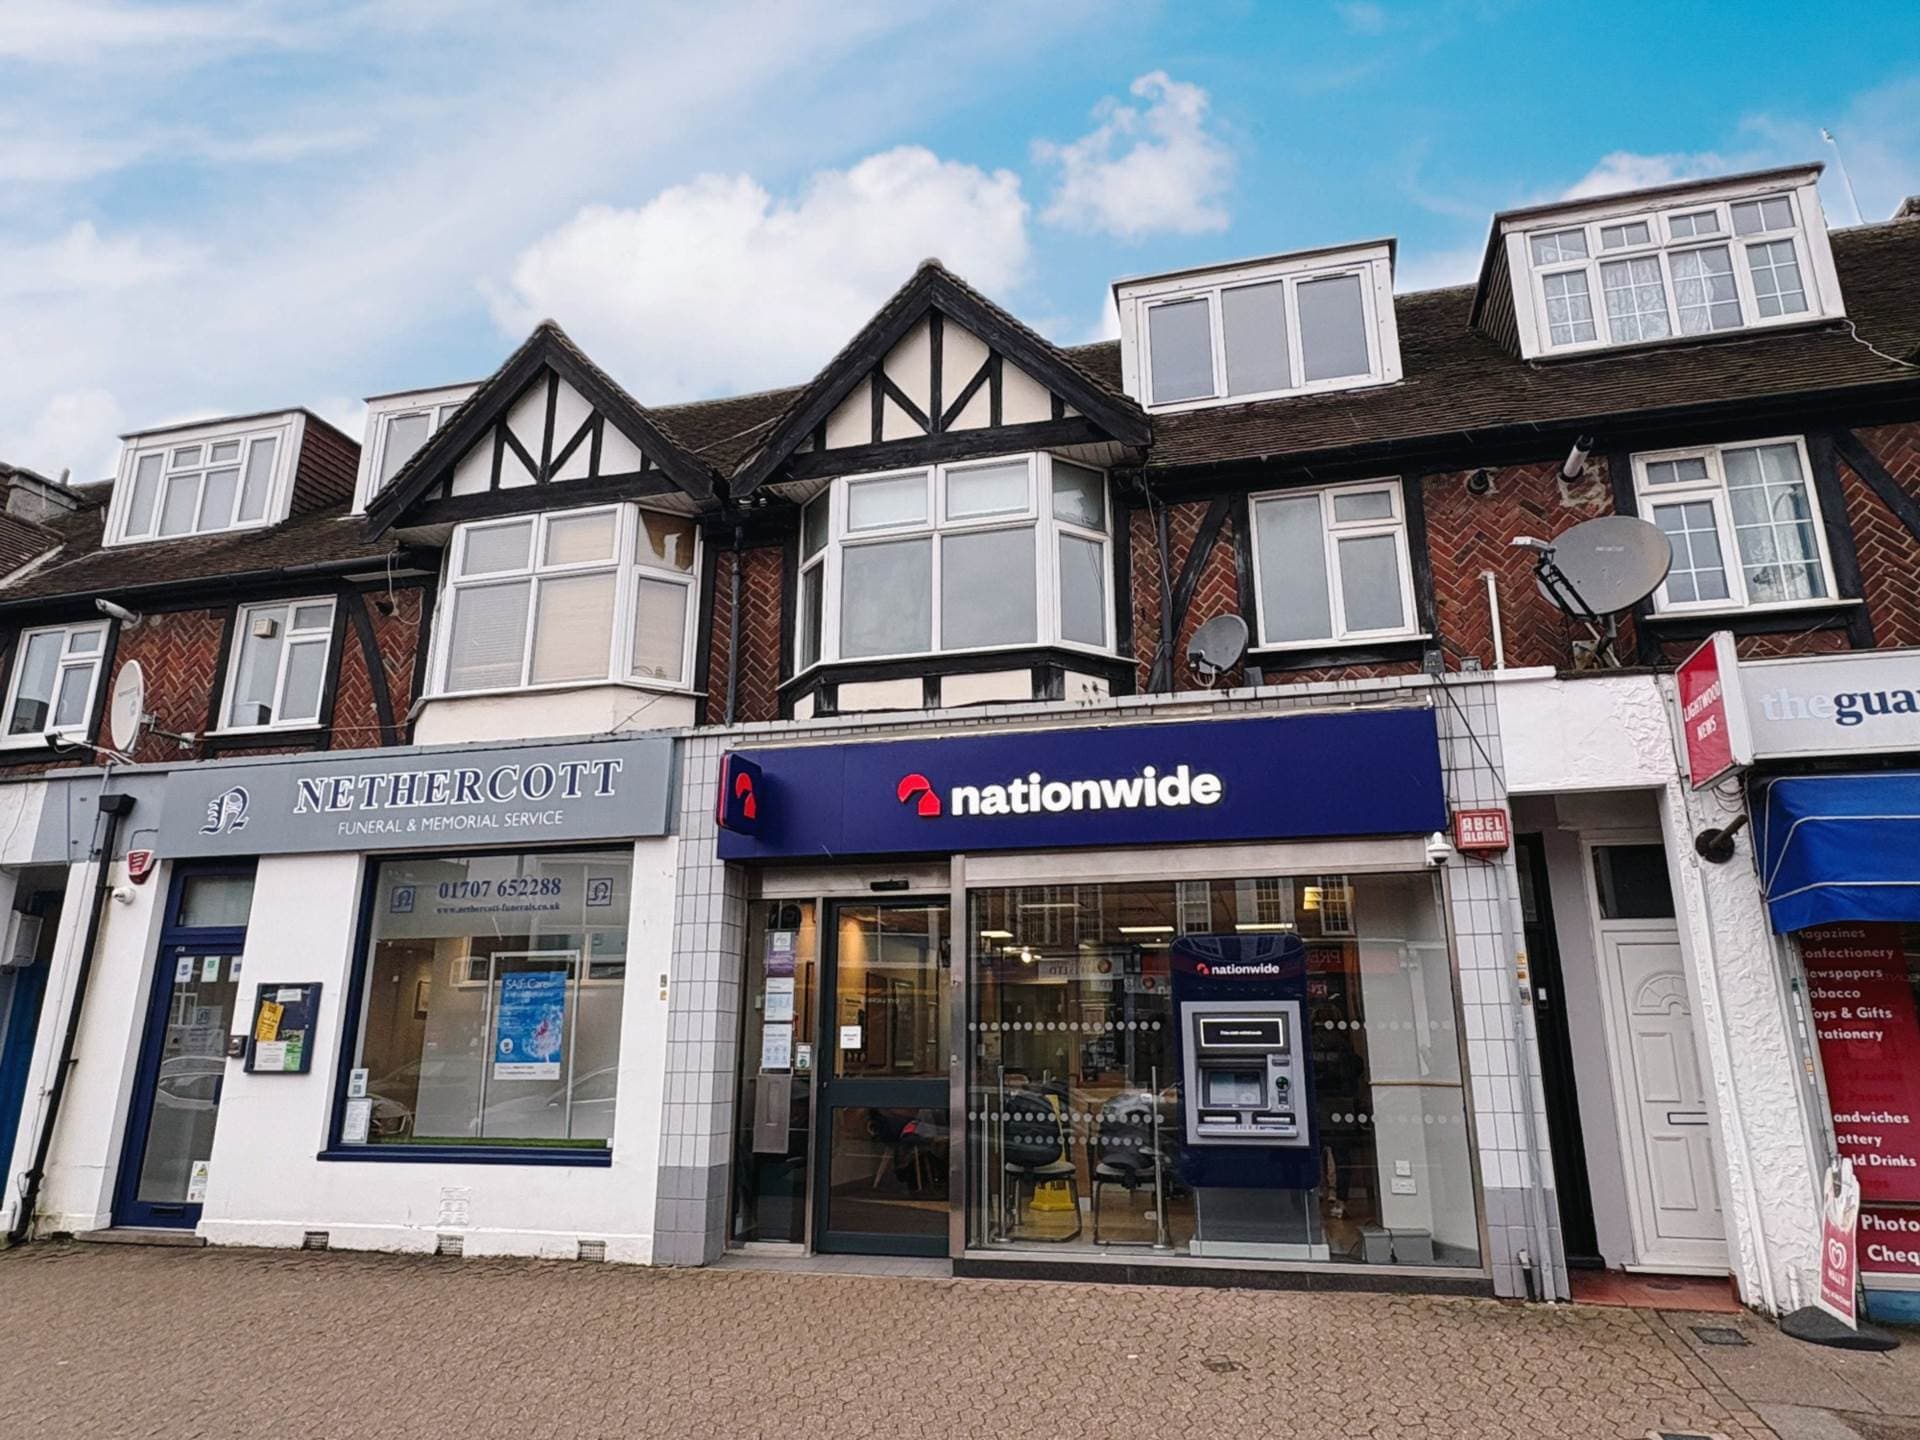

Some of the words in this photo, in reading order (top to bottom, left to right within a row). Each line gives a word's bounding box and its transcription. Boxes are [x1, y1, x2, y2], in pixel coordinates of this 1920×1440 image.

[1760, 688, 1920, 726] thegua
[1697, 714, 1717, 741] NEWS
[294, 759, 623, 813] NETHERCOTT
[951, 765, 1222, 816] nationwide
[338, 818, 402, 836] FUNERAL
[406, 818, 417, 831] &
[421, 814, 499, 831] MEMORIAL
[504, 810, 564, 828] SERVICE
[1462, 816, 1503, 831] ABEL
[1463, 831, 1504, 842] ALARM
[439, 880, 492, 899] 01707
[497, 878, 562, 897] 652288
[1803, 947, 1894, 959] onfectionery
[1211, 963, 1280, 975] nationwide
[1808, 968, 1883, 980] ewspapers
[1809, 987, 1861, 999] obacco
[1813, 1007, 1837, 1021] oys
[1841, 1007, 1852, 1018] &
[1856, 1006, 1893, 1019] Gifts
[1818, 1028, 1883, 1041] tationery
[1834, 1111, 1910, 1124] andwiches
[1838, 1134, 1882, 1147] ottery
[1869, 1154, 1917, 1167] Drinks
[1861, 1213, 1920, 1233] Photo
[1867, 1244, 1920, 1267] Cheq
